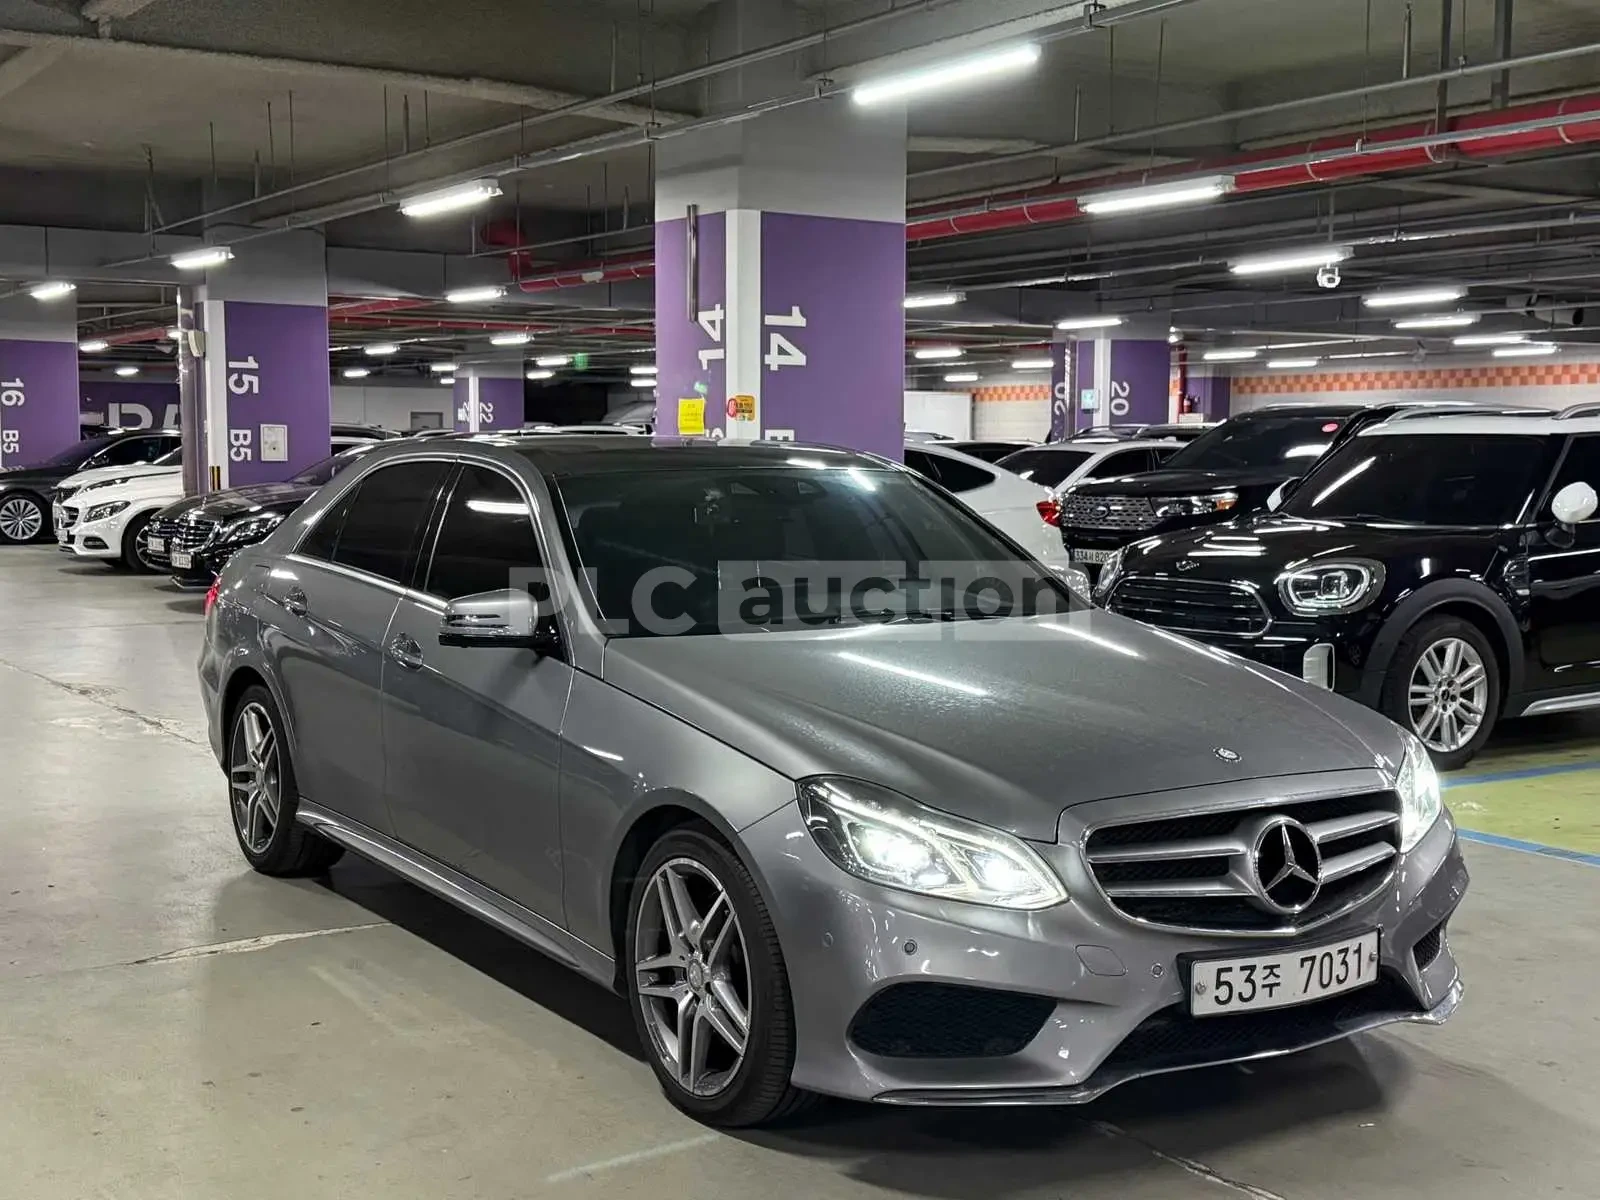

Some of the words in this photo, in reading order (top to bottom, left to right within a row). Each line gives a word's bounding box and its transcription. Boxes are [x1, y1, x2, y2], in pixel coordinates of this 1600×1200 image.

[698, 303, 725, 371] 14
[764, 305, 807, 371] 14
[1, 378, 25, 407] 16
[228, 355, 259, 395] 15
[480, 402, 493, 423] 22
[1111, 380, 1130, 416] 20
[2, 429, 20, 454] B5
[229, 428, 252, 462] B5
[1214, 963, 1281, 1006] 53주
[1300, 942, 1363, 994] 7031
